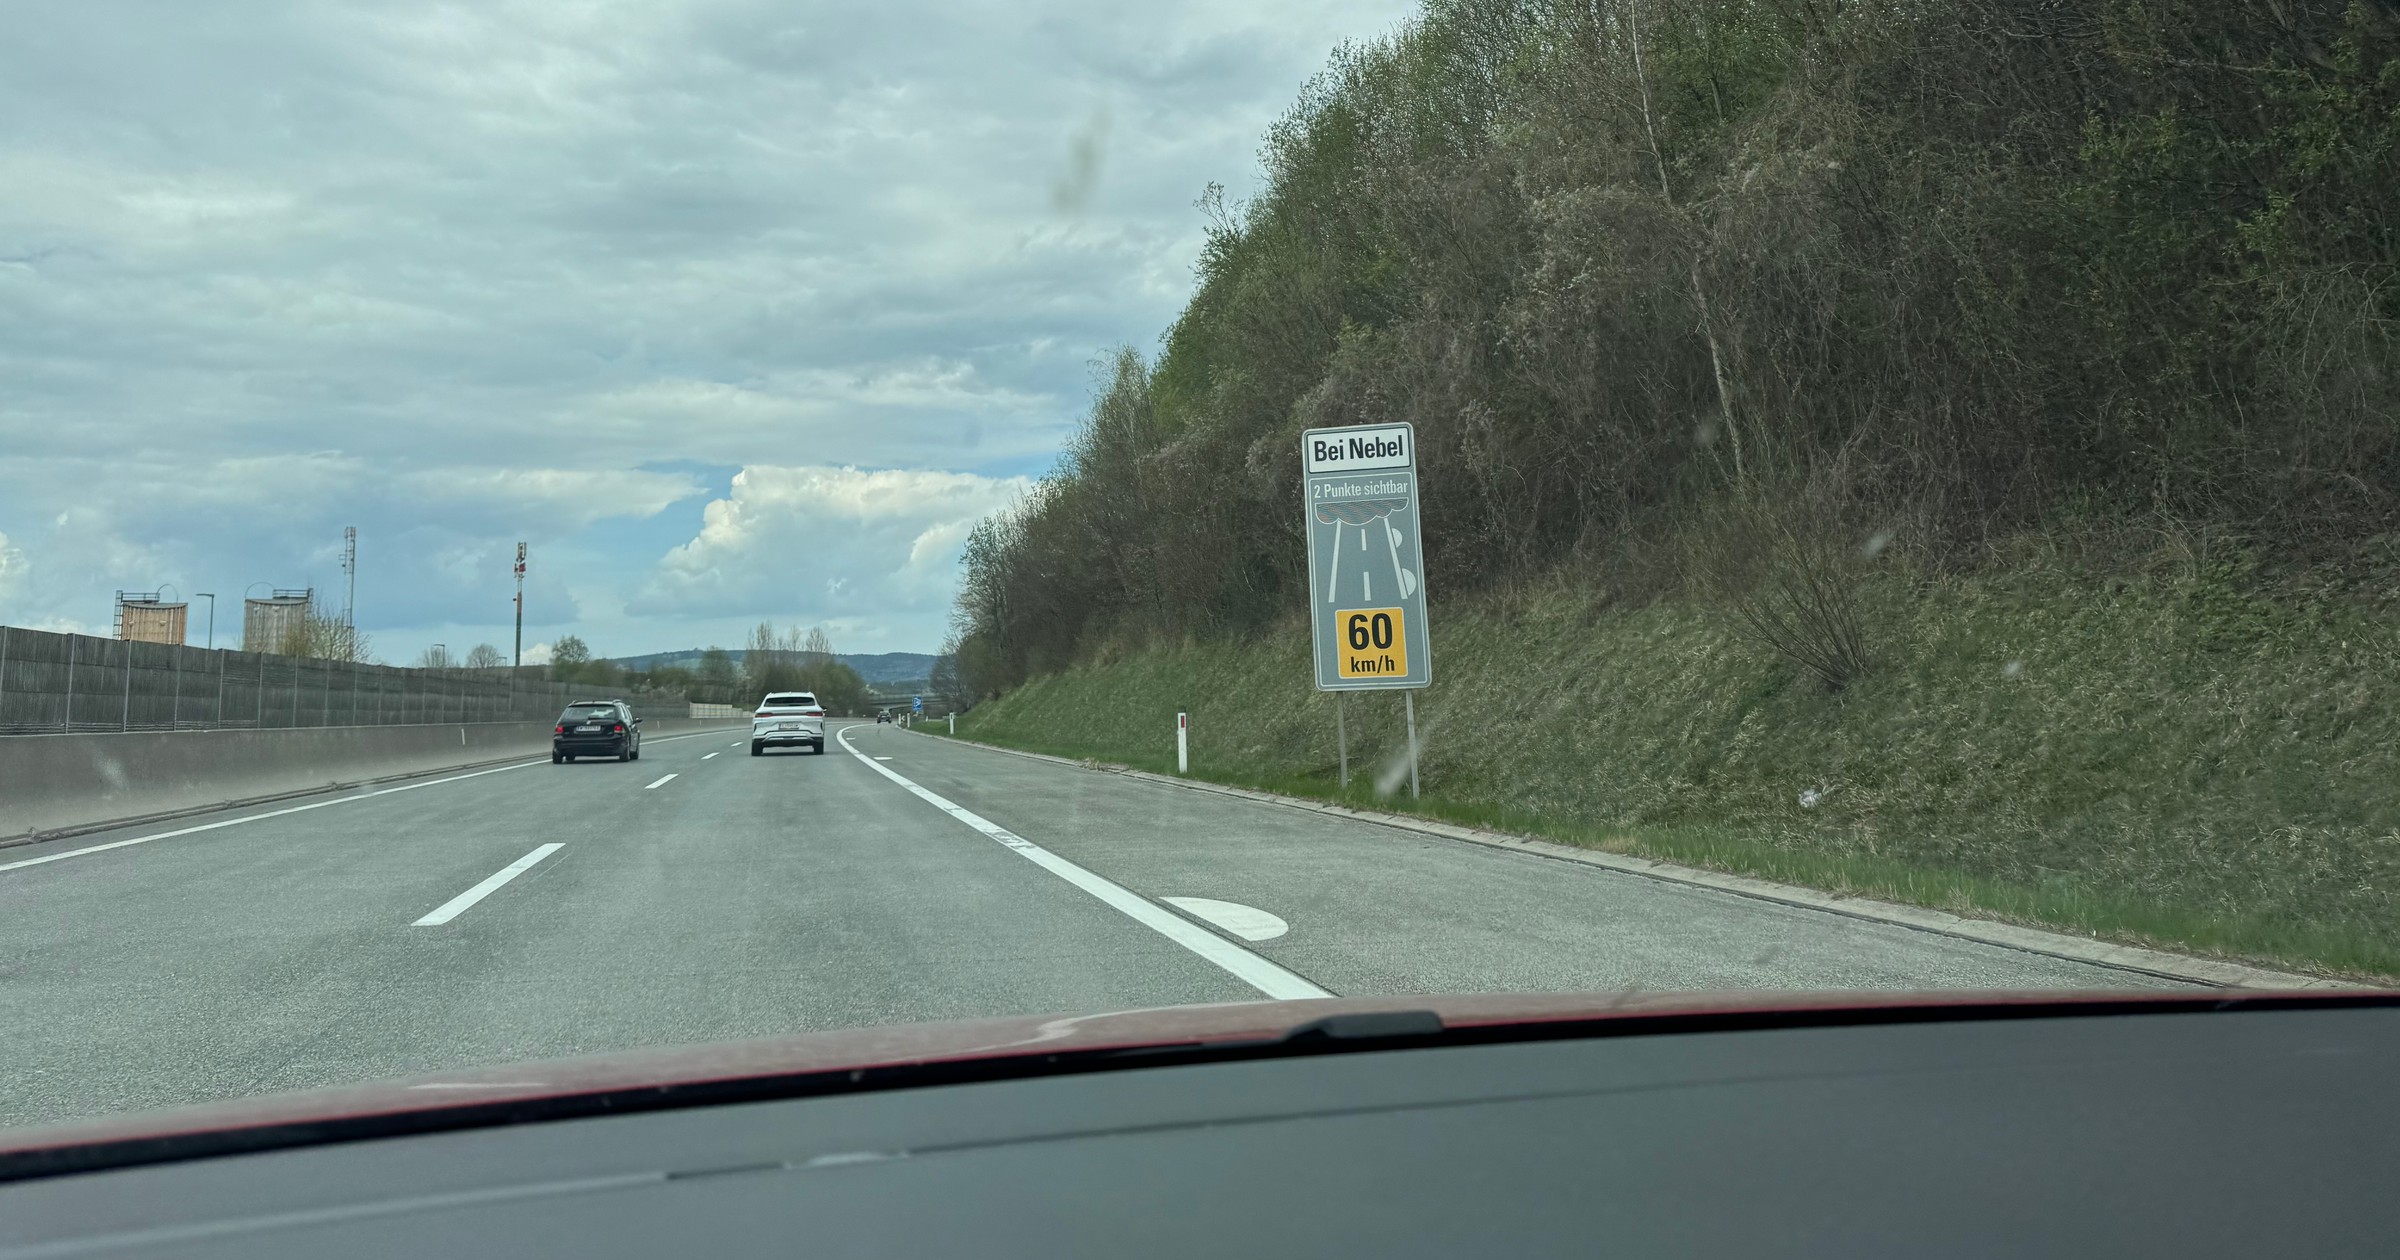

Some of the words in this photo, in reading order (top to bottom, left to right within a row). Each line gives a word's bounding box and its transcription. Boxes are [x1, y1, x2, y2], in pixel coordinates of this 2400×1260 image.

[1314, 439, 1344, 462] Bei
[1349, 435, 1403, 460] Nebel
[1314, 485, 1321, 499] 2
[1324, 482, 1362, 498] Punkte
[1364, 480, 1408, 497] sichtbar
[1349, 613, 1393, 650] 60
[1351, 655, 1394, 674] km/h
